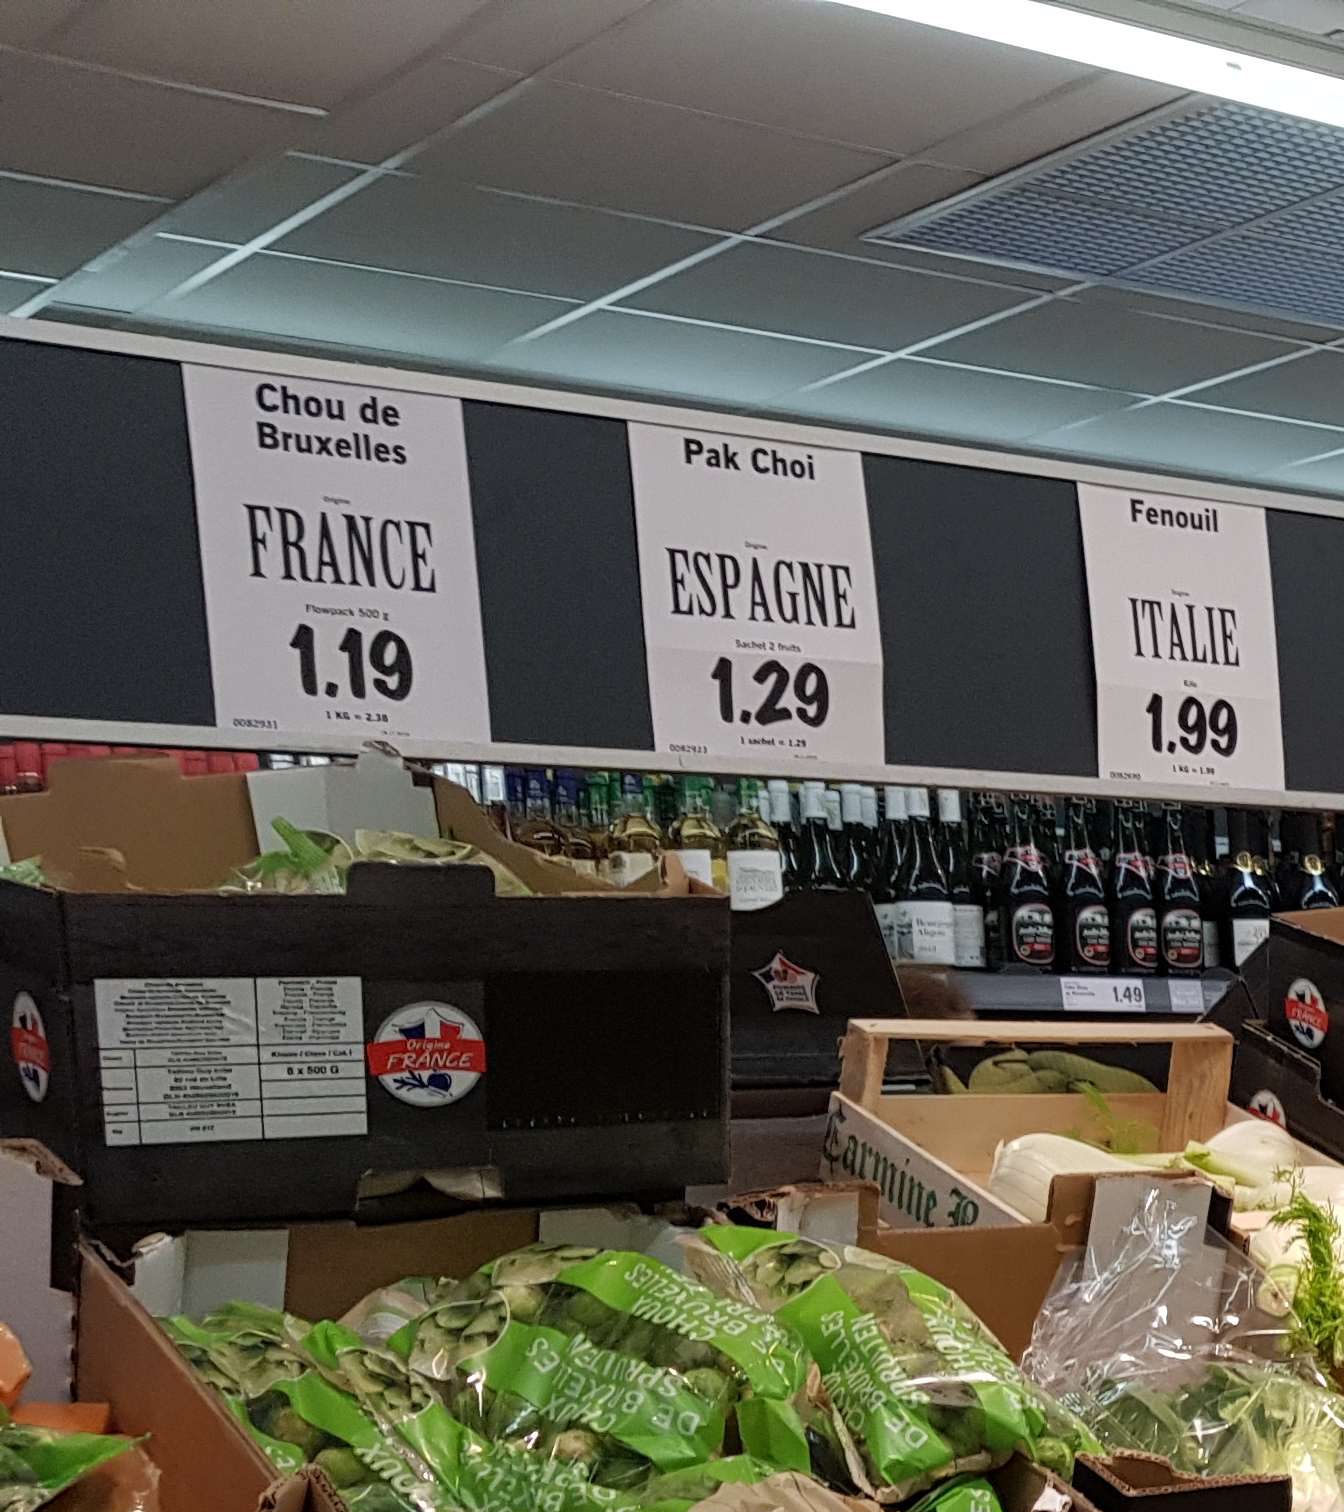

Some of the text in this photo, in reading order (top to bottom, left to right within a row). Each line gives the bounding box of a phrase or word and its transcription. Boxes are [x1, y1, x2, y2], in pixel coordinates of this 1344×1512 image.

[255, 383, 400, 427] Chou de
[256, 421, 407, 465] Bruxelles
[683, 438, 816, 481] Pak Choi
[1130, 498, 1219, 534] Fenouil
[242, 503, 437, 594] FRANCE
[664, 547, 857, 630] ESPAGNE
[1127, 597, 1240, 668] ITALIE
[289, 623, 413, 702] 1.19
[710, 656, 830, 729] 1.29
[1145, 692, 1238, 758] 1.99
[1112, 985, 1143, 1002] 1.49
[386, 1050, 474, 1071] FRANCE
[406, 1039, 451, 1053] Origine
[631, 1295, 717, 1342] CHOUX
[652, 1402, 701, 1436] DE
[884, 1407, 929, 1449] DE
